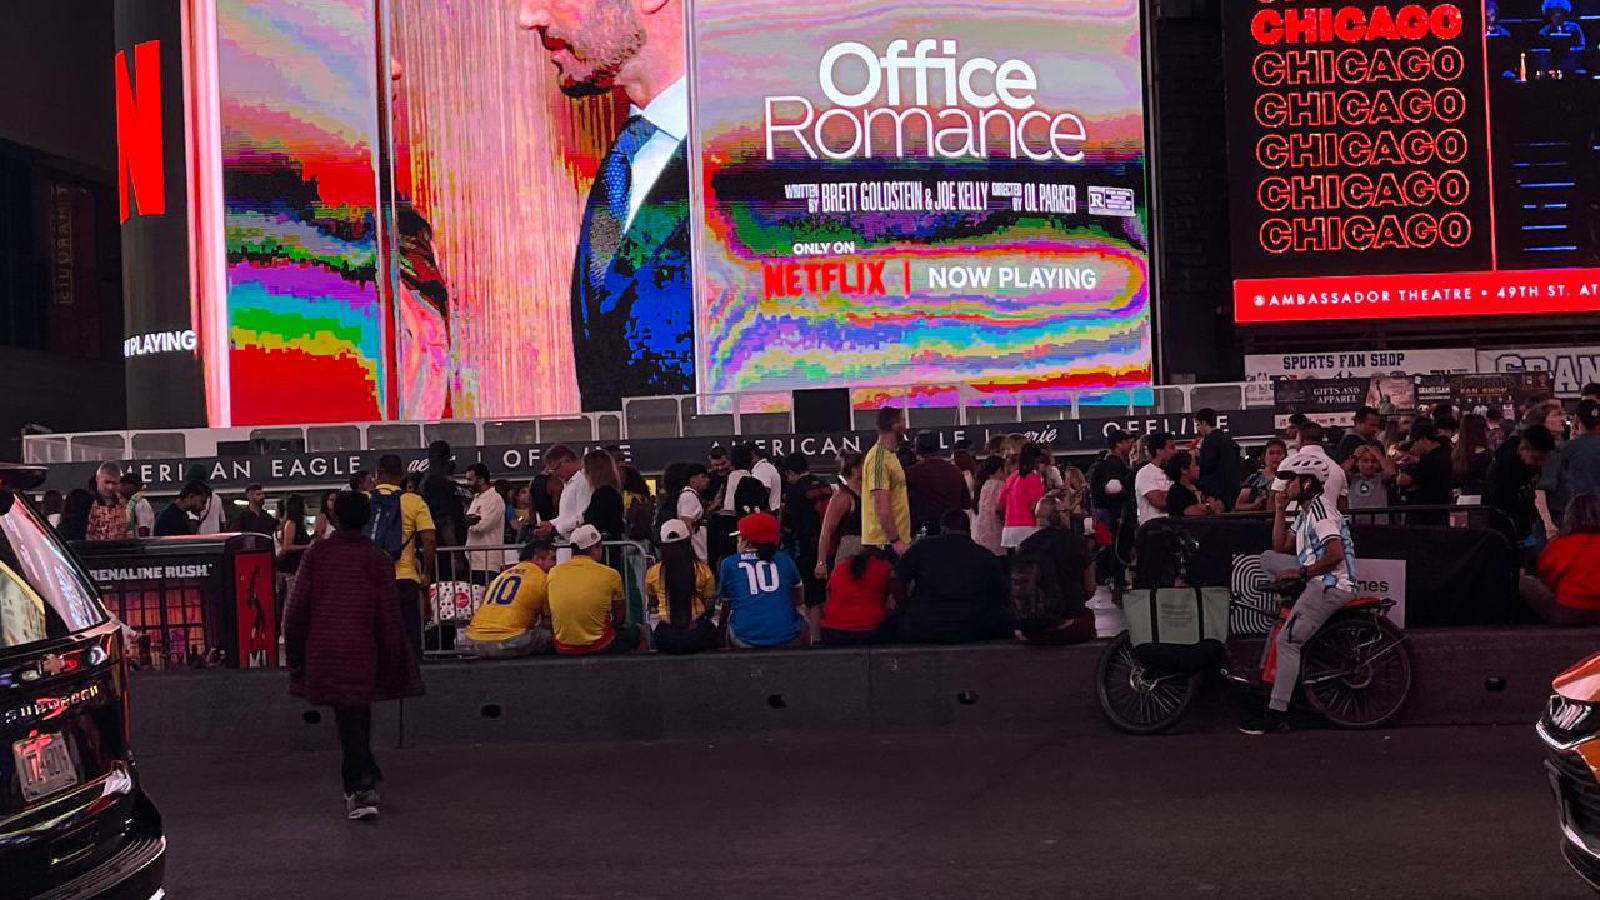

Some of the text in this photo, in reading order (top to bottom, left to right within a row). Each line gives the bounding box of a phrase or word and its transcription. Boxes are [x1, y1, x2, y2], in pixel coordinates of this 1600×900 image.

[1251, 4, 1462, 44] CHICAGO
[819, 39, 1037, 108] Office
[1253, 45, 1464, 86] CHICAGO
[1255, 87, 1466, 128] CHICAGO
[764, 95, 1087, 162] Romance
[1256, 128, 1468, 169] CHICAGO
[821, 182, 857, 212] BRETT
[860, 181, 922, 211] GOLDSTEIN
[925, 188, 932, 210] &
[935, 181, 956, 211] JOE
[958, 181, 987, 211] KELLY
[1024, 183, 1037, 211] OL
[1039, 184, 1077, 214] PARKER
[1258, 170, 1470, 211] CHICAGO
[793, 241, 855, 255] ONLY ON
[1260, 212, 1472, 254] CHICAGO
[763, 260, 1097, 300] NETFLIX NOW PLAYING
[1269, 283, 1598, 306] AMBASSADOR THEATRE 49TH ST. AT
[1283, 353, 1405, 370] SPORTS FAN SHOP
[271, 455, 361, 478] EAGLE
[738, 559, 780, 595] 10
